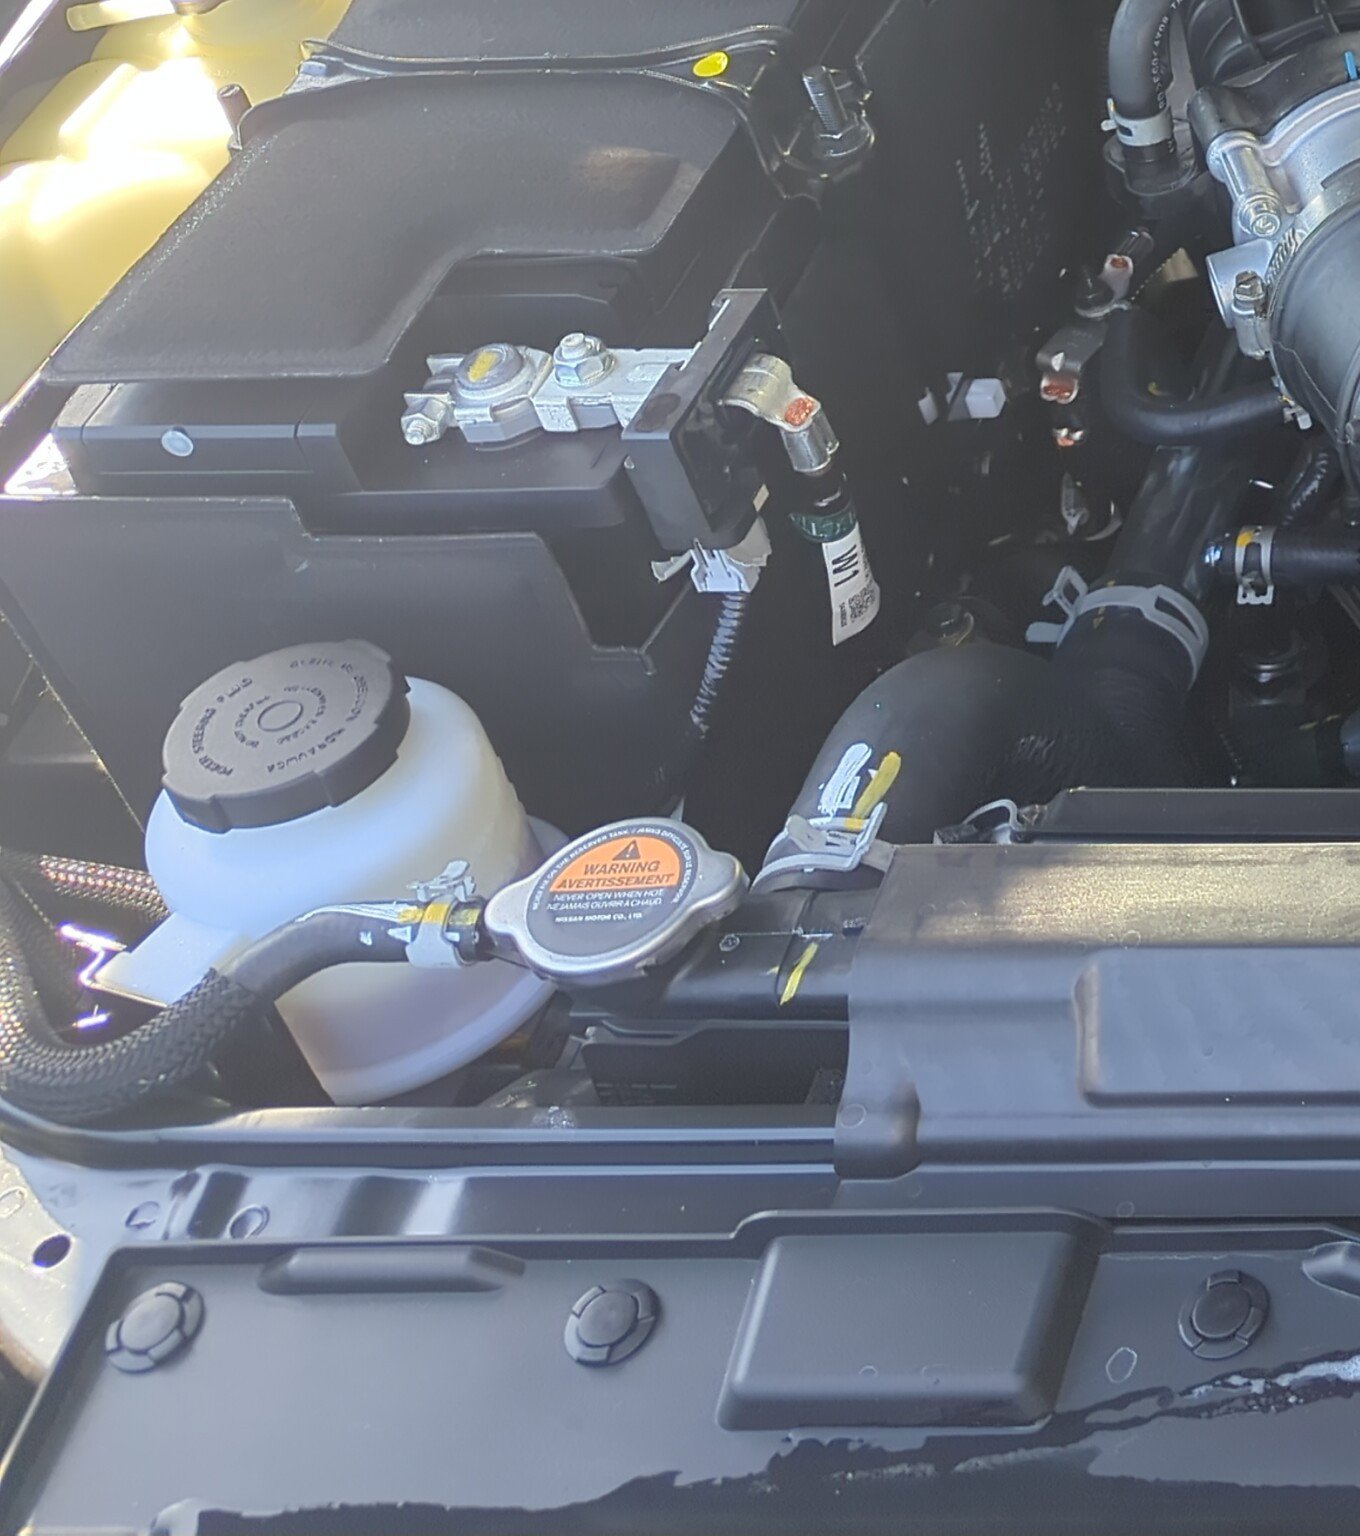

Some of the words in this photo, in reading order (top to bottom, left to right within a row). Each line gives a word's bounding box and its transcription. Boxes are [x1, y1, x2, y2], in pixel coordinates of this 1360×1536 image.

[831, 544, 860, 588] W1
[584, 860, 660, 876] WARNING
[556, 873, 675, 889] AVERTISSEMENT
[553, 893, 584, 902] NEVER
[585, 892, 611, 901] OPEN
[613, 890, 642, 899] WHEN
